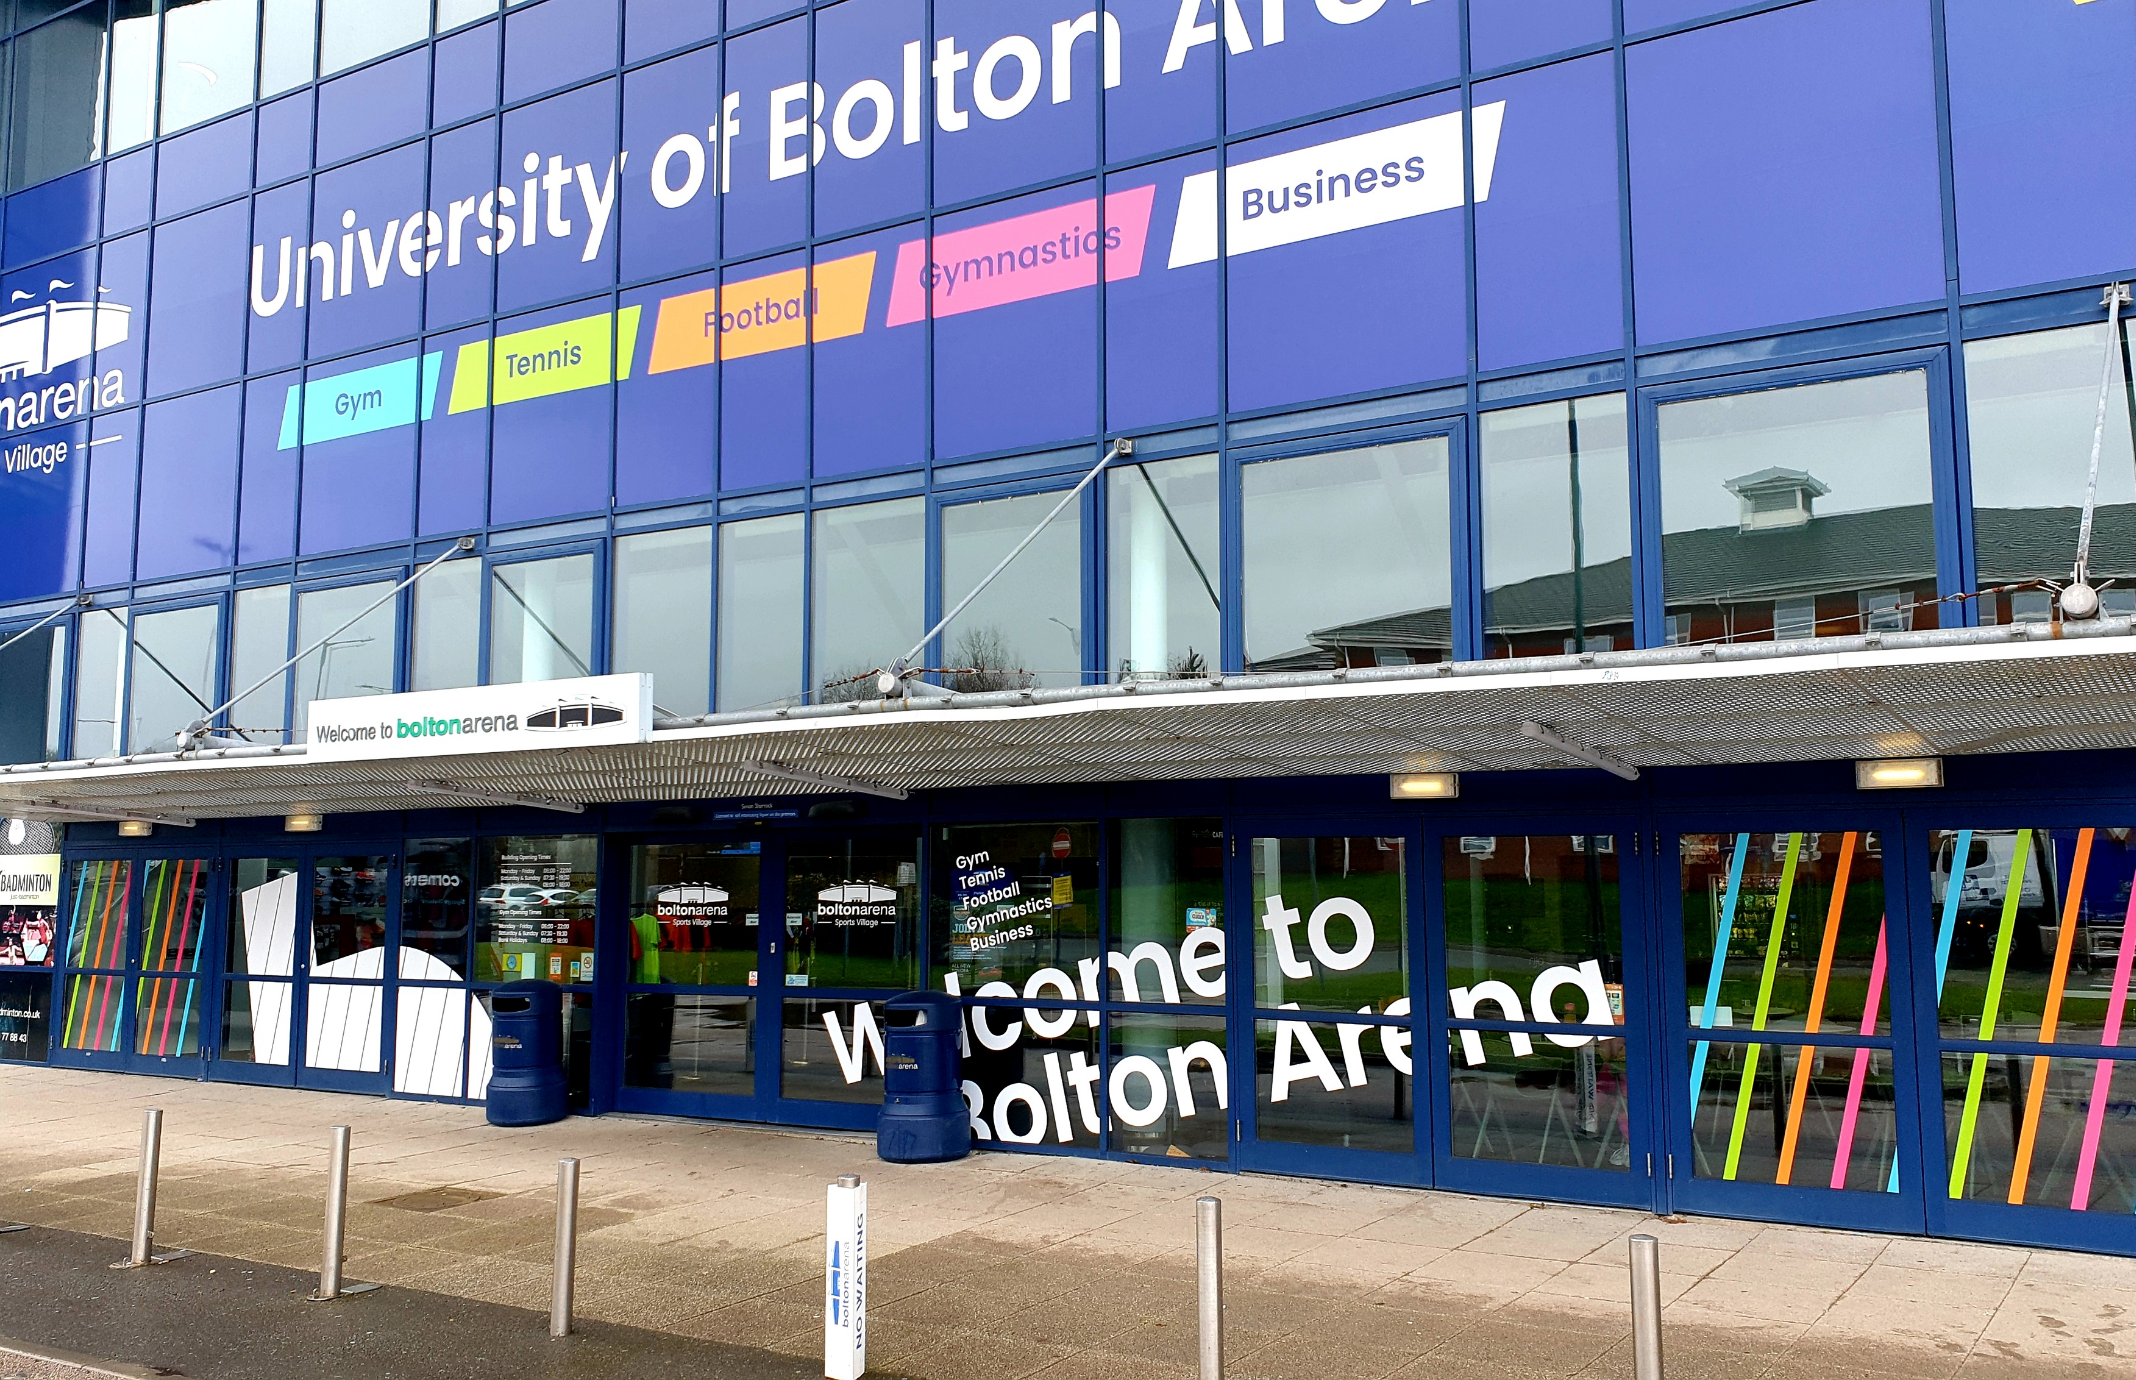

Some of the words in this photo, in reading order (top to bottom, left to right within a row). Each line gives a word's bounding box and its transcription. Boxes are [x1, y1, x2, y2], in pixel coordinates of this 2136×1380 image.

[250, 151, 627, 318] University
[650, 91, 740, 208] of
[769, 10, 1122, 182] Bolton
[1242, 155, 1425, 221] Business
[919, 225, 1121, 297] Gymnastics
[704, 287, 819, 338] Football
[505, 340, 582, 378] Tennis
[334, 389, 382, 420] Gym
[4, 441, 68, 474] Village
[316, 723, 376, 743] Welcome
[380, 721, 393, 739] to
[396, 711, 519, 739] boltonarena
[956, 850, 990, 871] Gym
[0, 874, 52, 892] BADMINTON
[959, 865, 1006, 890] Tennis
[658, 904, 728, 915] boltonarena
[818, 903, 896, 915] boltonarena
[962, 881, 1020, 910] Football
[672, 919, 691, 927] Sports
[692, 919, 712, 927] Village
[835, 919, 855, 927] Sports
[856, 919, 878, 928] Village
[966, 896, 1053, 933] Gymnastics
[970, 924, 1034, 952] Business
[822, 926, 1226, 1084] Wlcome
[1262, 894, 1375, 979] to
[19, 1034, 27, 1042] 43
[1270, 959, 1616, 1103] Arena
[856, 1317, 863, 1349] NO
